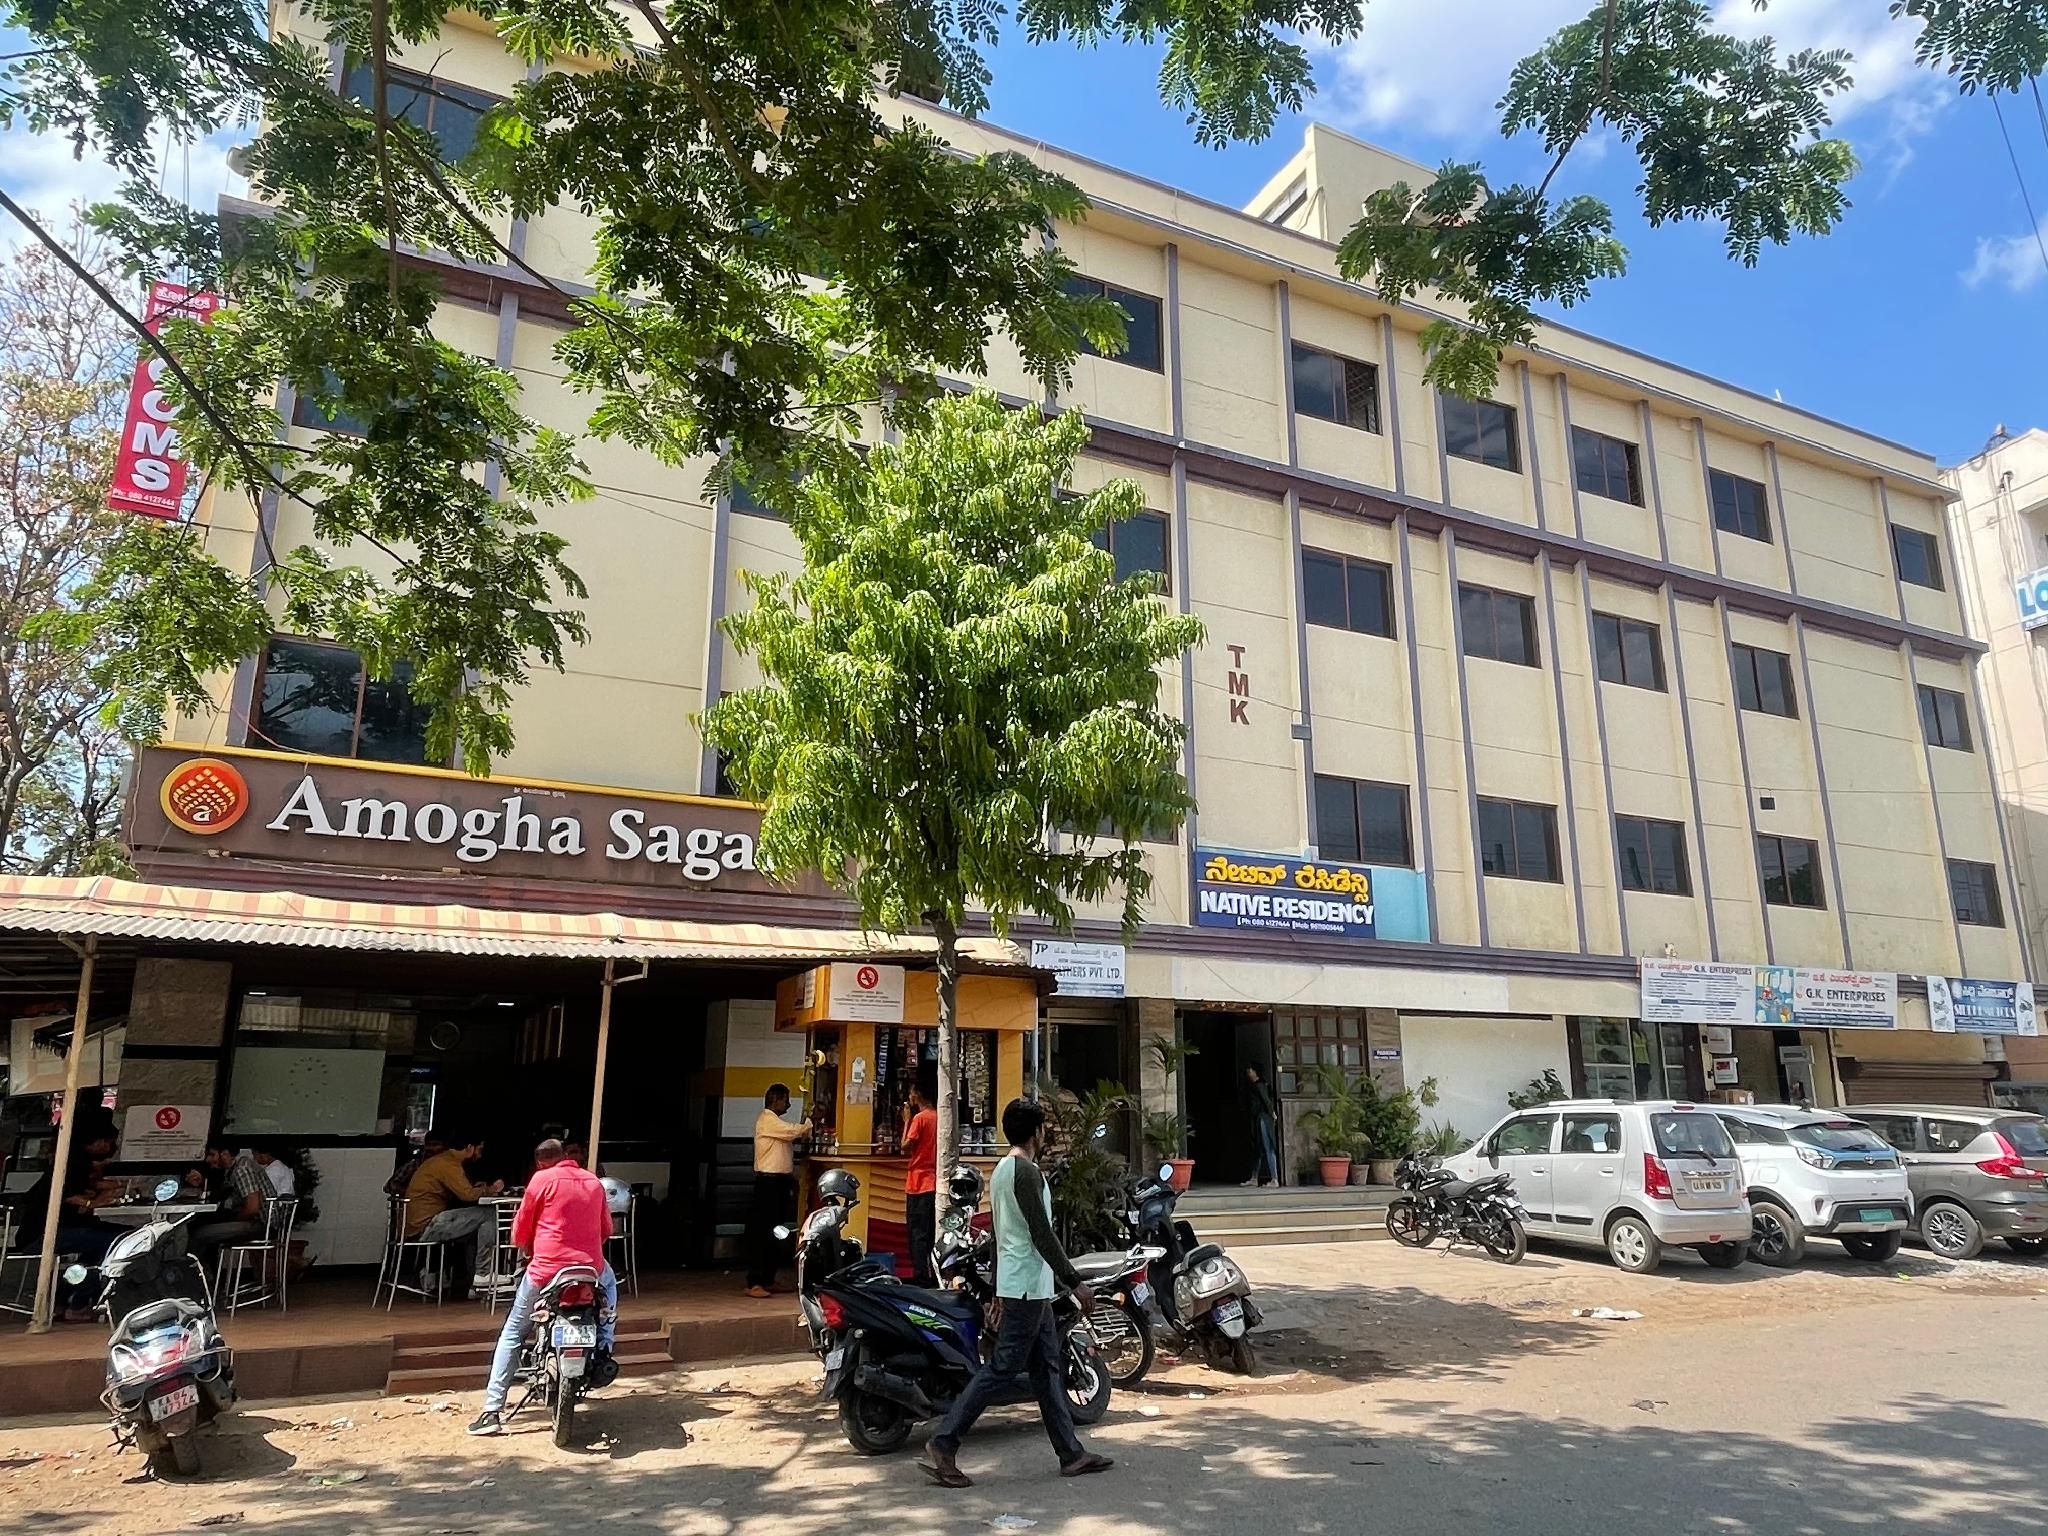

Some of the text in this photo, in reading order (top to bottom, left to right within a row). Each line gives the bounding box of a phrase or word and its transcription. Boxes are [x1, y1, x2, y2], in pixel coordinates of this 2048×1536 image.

[1226, 643, 1250, 726] TMK
[266, 775, 770, 882] Amogha Saga
[1200, 890, 1374, 925] NATIVE RESIDENCY
[1826, 989, 1887, 1002] ENTERPRISES
